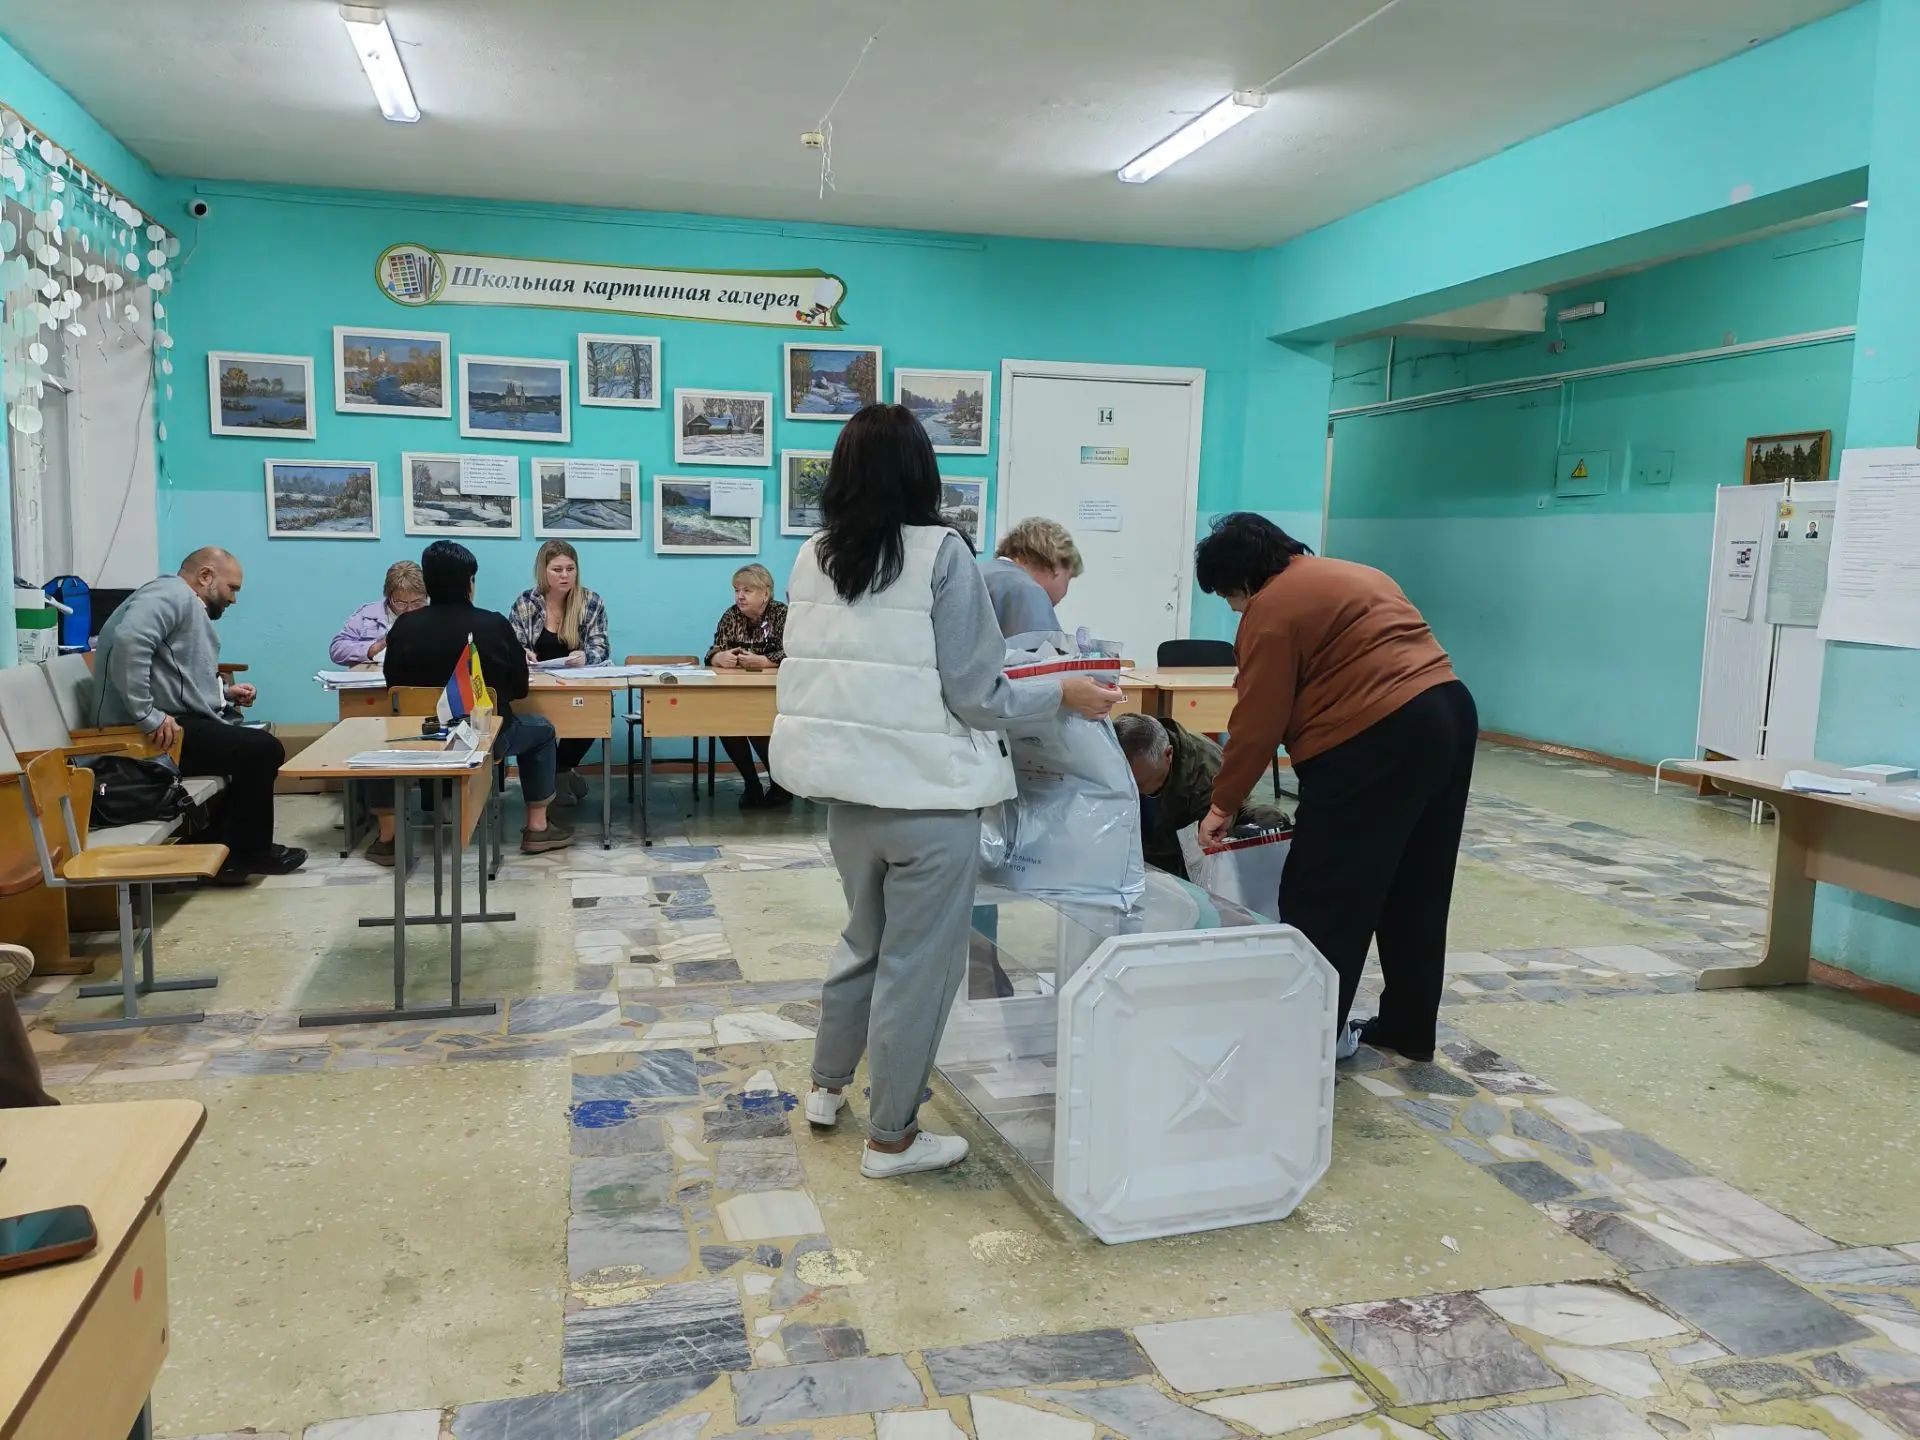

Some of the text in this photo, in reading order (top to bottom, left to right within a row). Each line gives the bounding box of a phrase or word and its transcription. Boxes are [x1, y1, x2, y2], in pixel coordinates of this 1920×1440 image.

[450, 266, 800, 310] Школьная картинная галерея
[1100, 410, 1112, 422] 14
